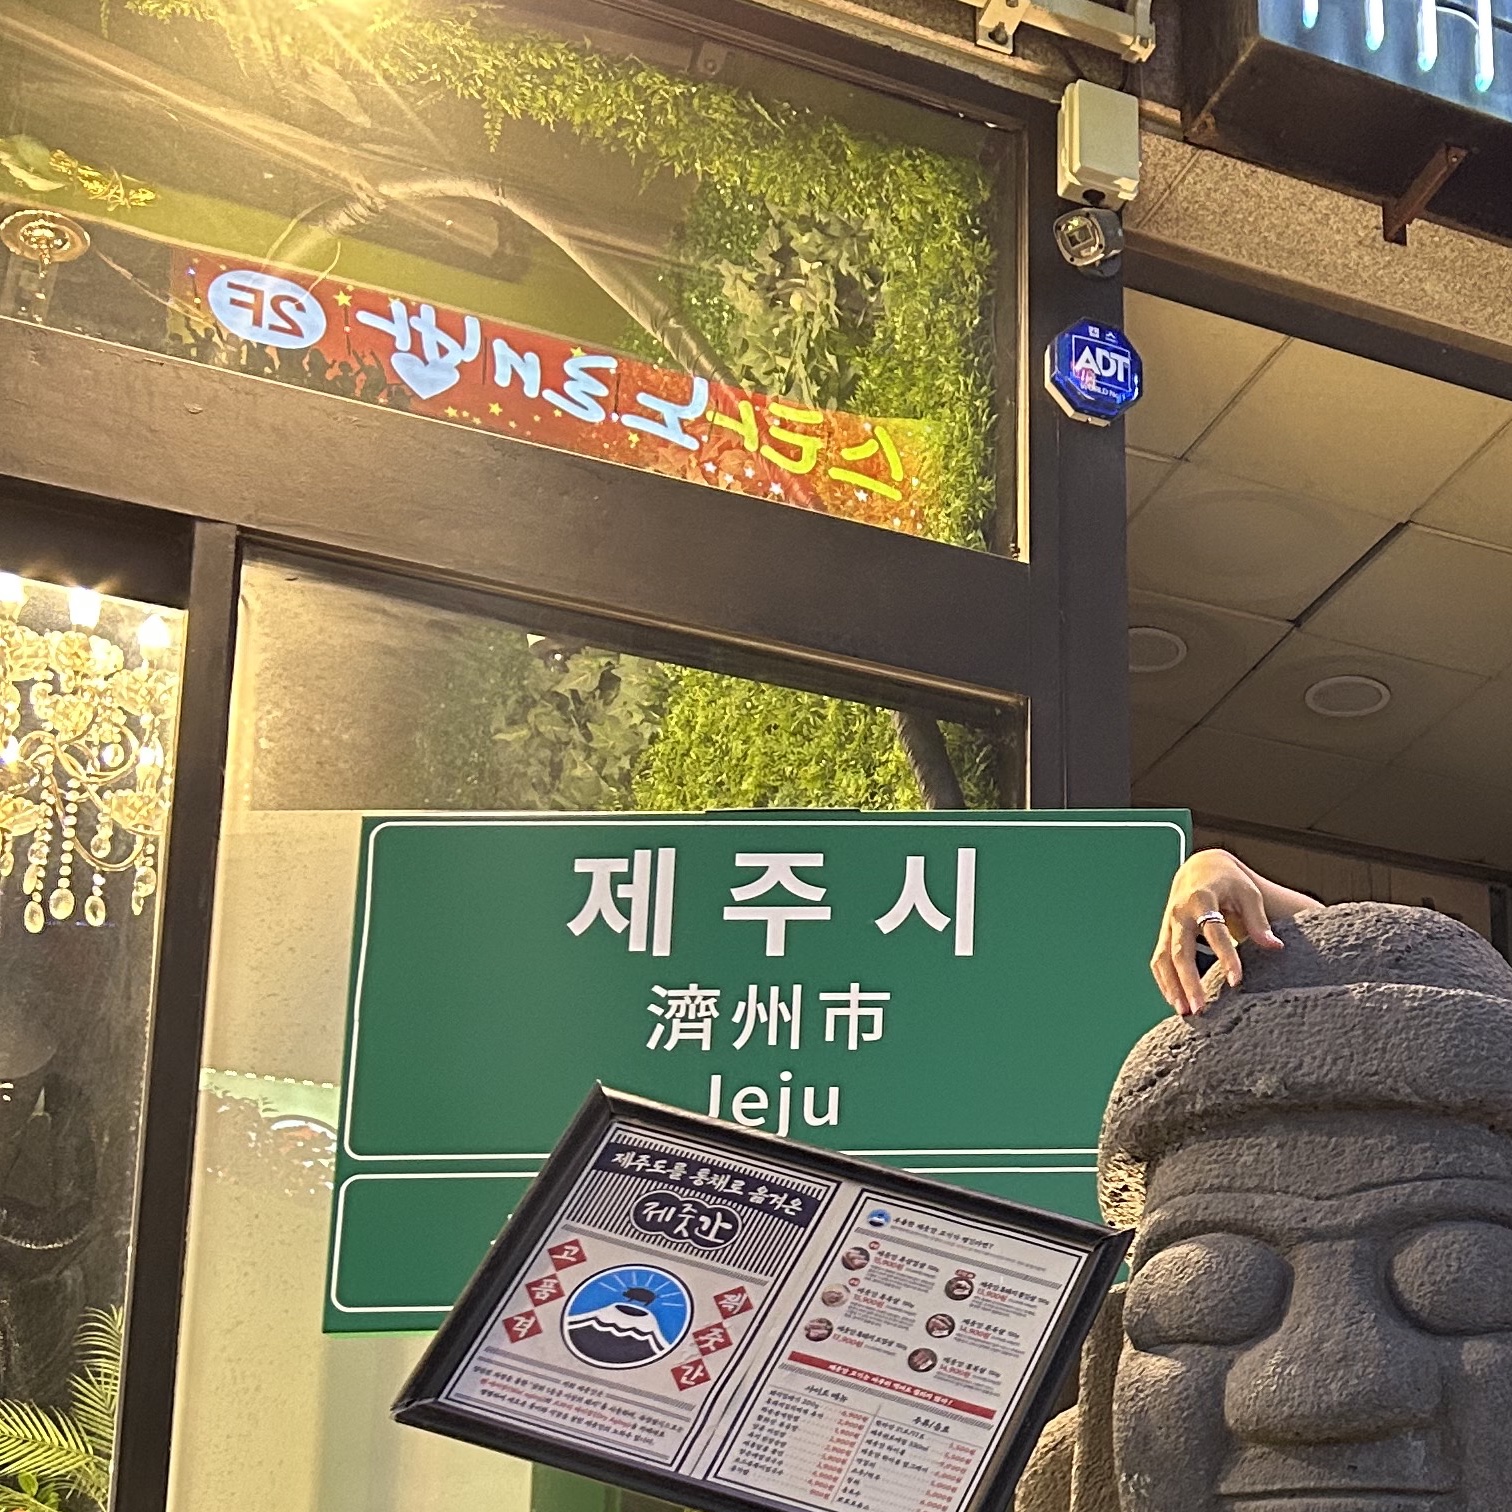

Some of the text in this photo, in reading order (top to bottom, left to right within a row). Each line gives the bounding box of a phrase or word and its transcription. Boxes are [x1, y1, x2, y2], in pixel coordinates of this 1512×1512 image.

[1074, 345, 1130, 383] ADT
[566, 846, 978, 958] 제주시
[645, 983, 892, 1053] 濟州市
[708, 1070, 839, 1137] Jeju
[610, 1151, 689, 1181] 제주도를
[642, 1200, 733, 1243] 제줏간
